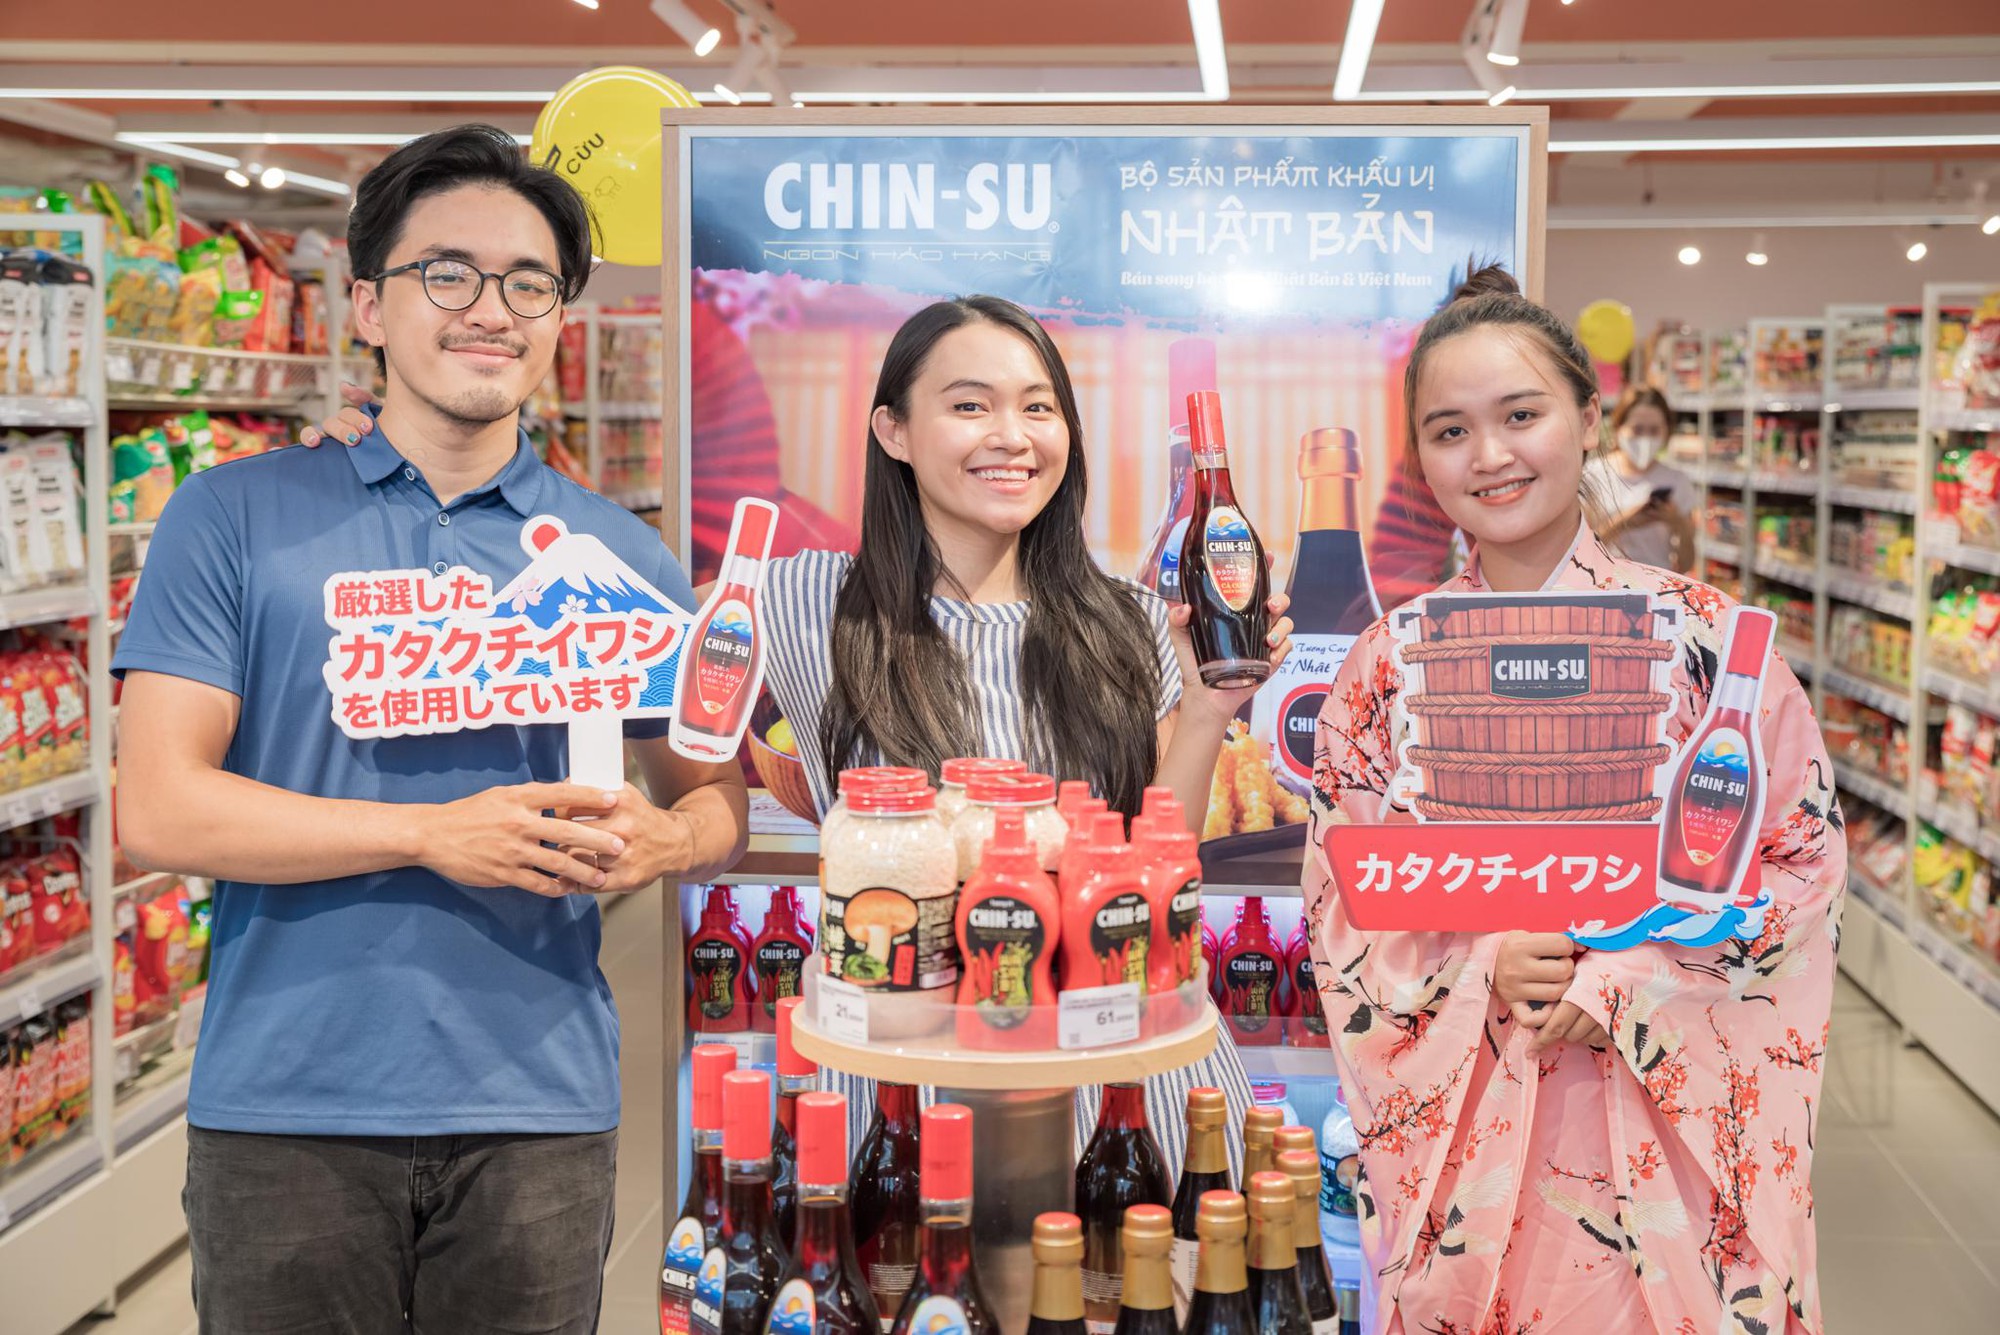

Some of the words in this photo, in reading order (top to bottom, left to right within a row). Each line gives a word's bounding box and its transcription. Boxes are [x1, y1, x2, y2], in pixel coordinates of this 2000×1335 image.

[1120, 160, 1158, 192] BỘ
[1167, 158, 1224, 188] SẢN
[1234, 156, 1319, 188] PHẨM
[1327, 156, 1401, 188] KHẨU
[1409, 165, 1435, 192] VỊ
[763, 162, 1051, 230] CHIN-SU
[1120, 195, 1293, 264] NHẬT
[1307, 193, 1434, 262] BẢN
[763, 248, 859, 261] NGON
[1343, 272, 1355, 287] &
[1357, 270, 1391, 289] Việt
[1394, 271, 1433, 287] Nam
[1208, 541, 1252, 553] CHIN-SU
[333, 575, 488, 619] 厳選した
[339, 616, 676, 683] カタクチイワシ
[704, 637, 751, 658] CHIN-SU
[1291, 658, 1331, 676] Nhật
[1494, 658, 1585, 681] CHIN-SU
[341, 675, 640, 728] を使用しています
[1690, 773, 1746, 797] CHIN-SU
[1354, 853, 1643, 894] カタクチイワシ
[968, 907, 1036, 930] CHIN-SU
[694, 947, 735, 959] CHIN-SU
[759, 947, 801, 960] CHIN-SU
[1230, 959, 1273, 972] CHIN-SU
